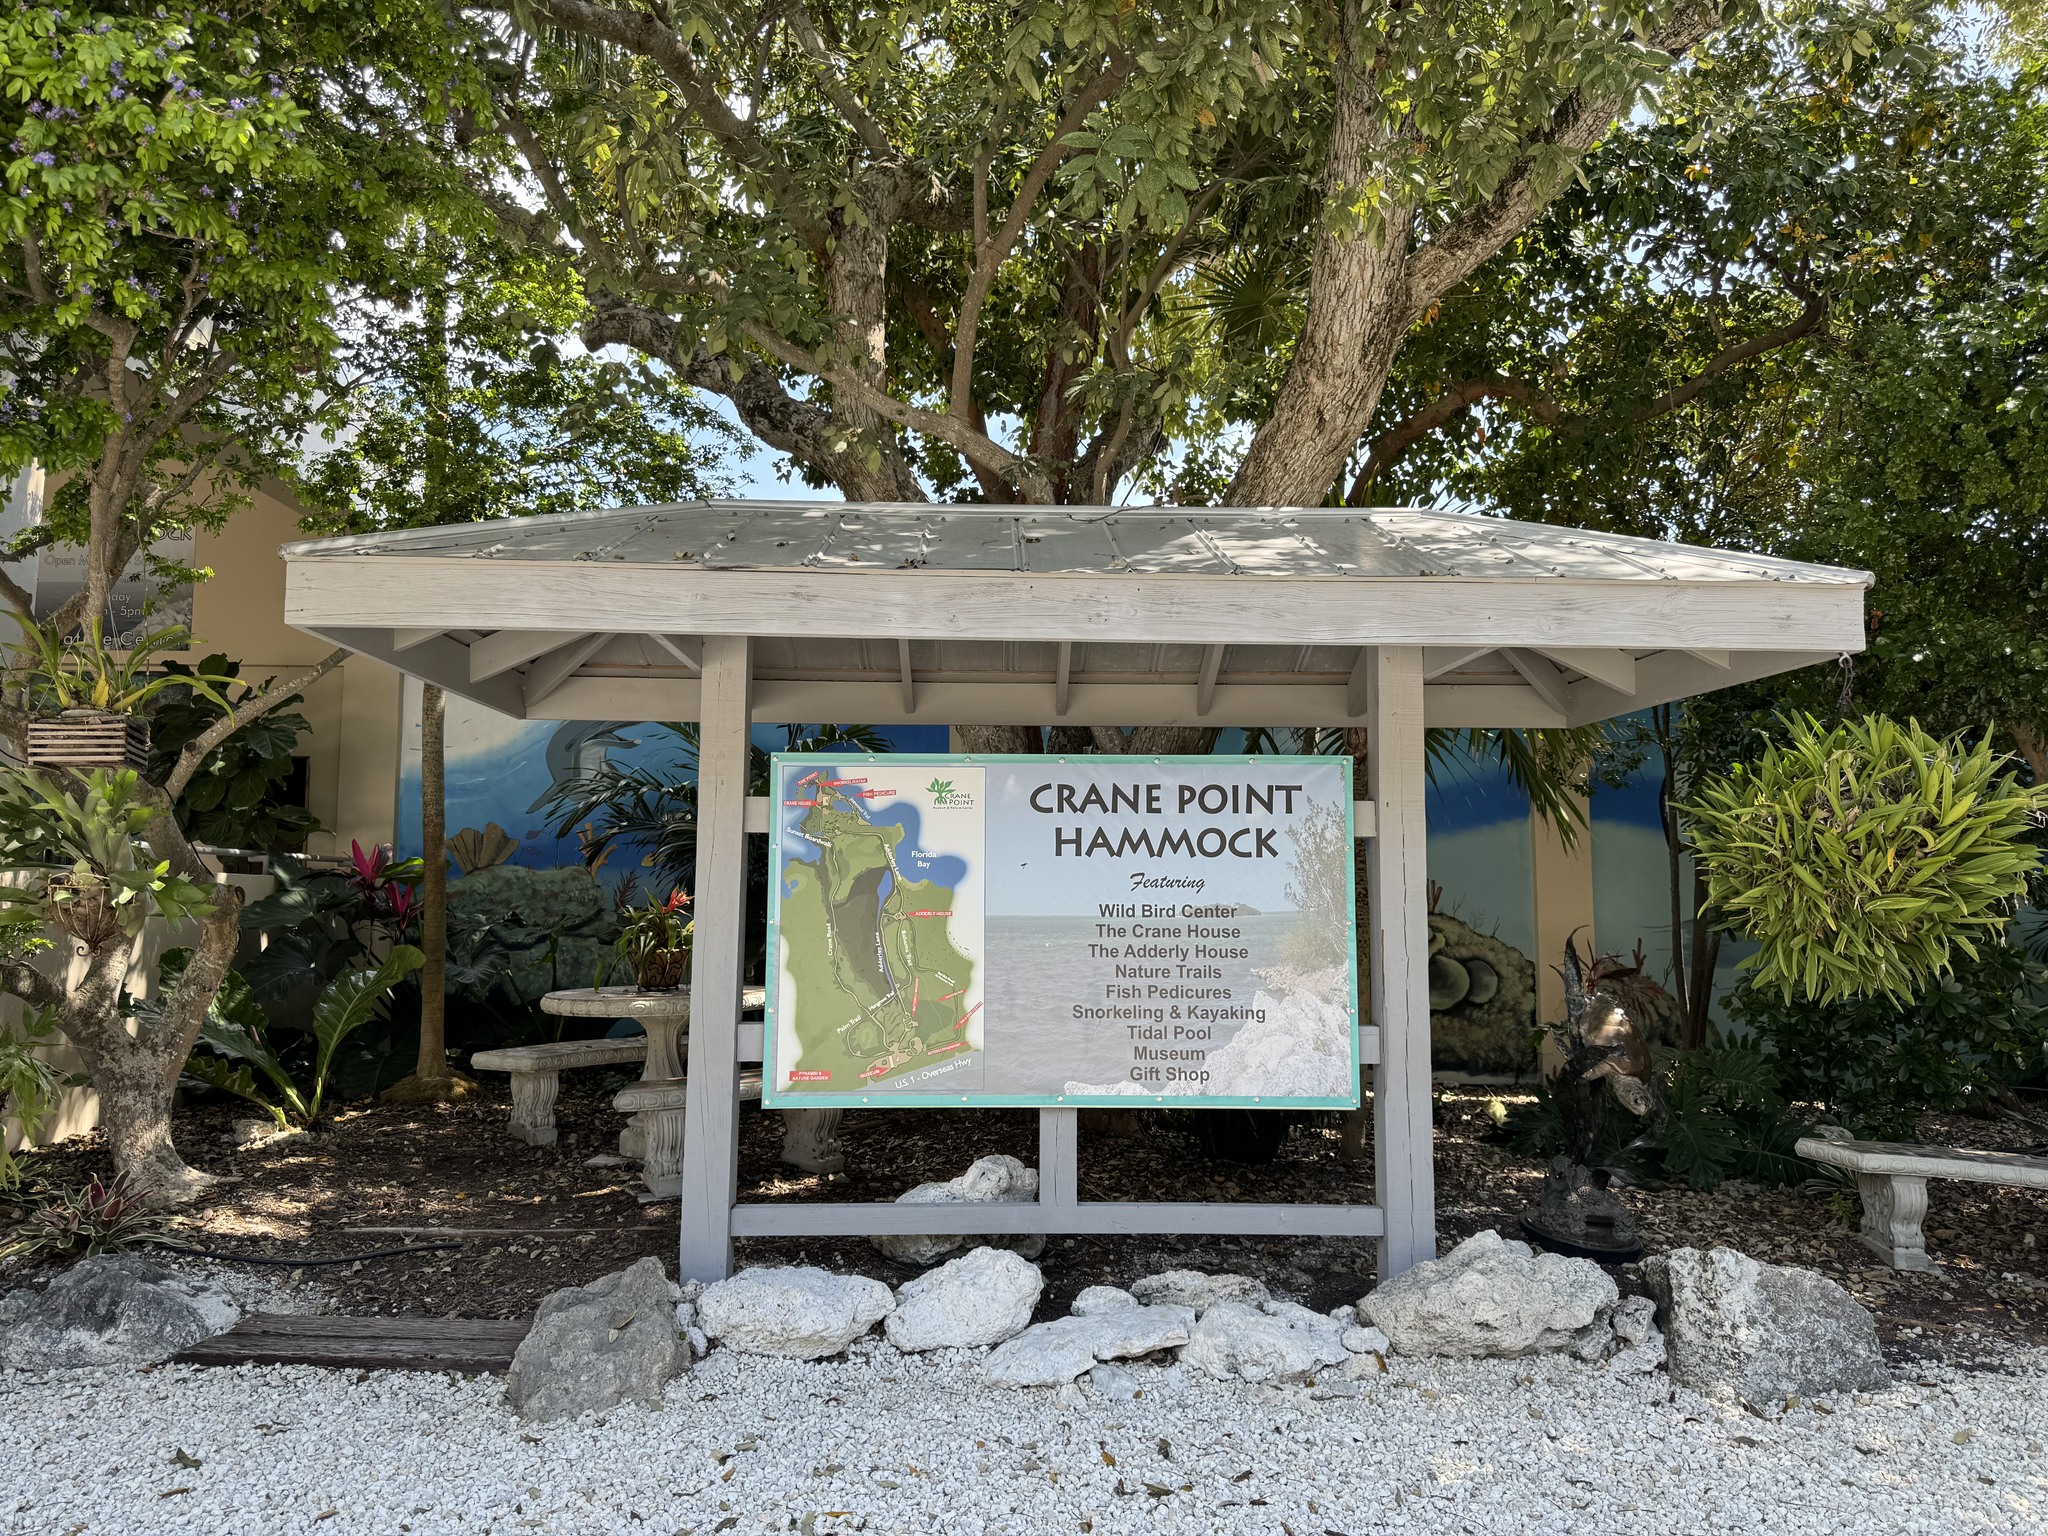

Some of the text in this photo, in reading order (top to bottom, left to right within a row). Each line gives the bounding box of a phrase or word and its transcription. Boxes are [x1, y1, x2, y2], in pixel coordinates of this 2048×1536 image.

[44, 554, 76, 568] Open
[1029, 782, 1303, 815] CRANE POINT
[786, 826, 833, 848] Sunset Boardwalk
[1054, 826, 1279, 859] HAMMOCK
[917, 861, 931, 869] Bay
[1129, 872, 1206, 894] Featuring
[1098, 904, 1238, 919] Wild Bird Center
[1095, 924, 1241, 939] The Crane House
[1088, 944, 1249, 962] The Adderly House
[1115, 965, 1222, 979] Nature Trails
[1105, 985, 1232, 999] Fish Pedicures
[1071, 1004, 1267, 1024] Snorkeling & Kayaking
[836, 1014, 862, 1034] Palm Trail
[1126, 1025, 1212, 1040] Tidal Pool
[1133, 1047, 1206, 1061] Museum
[859, 1069, 880, 1079] MUSEUM
[894, 1079, 910, 1090] U.S.
[910, 1075, 915, 1084] 1
[921, 1064, 954, 1080] Overseas
[953, 1057, 972, 1070] Hwy
[1129, 1066, 1210, 1084] Gift Shop
